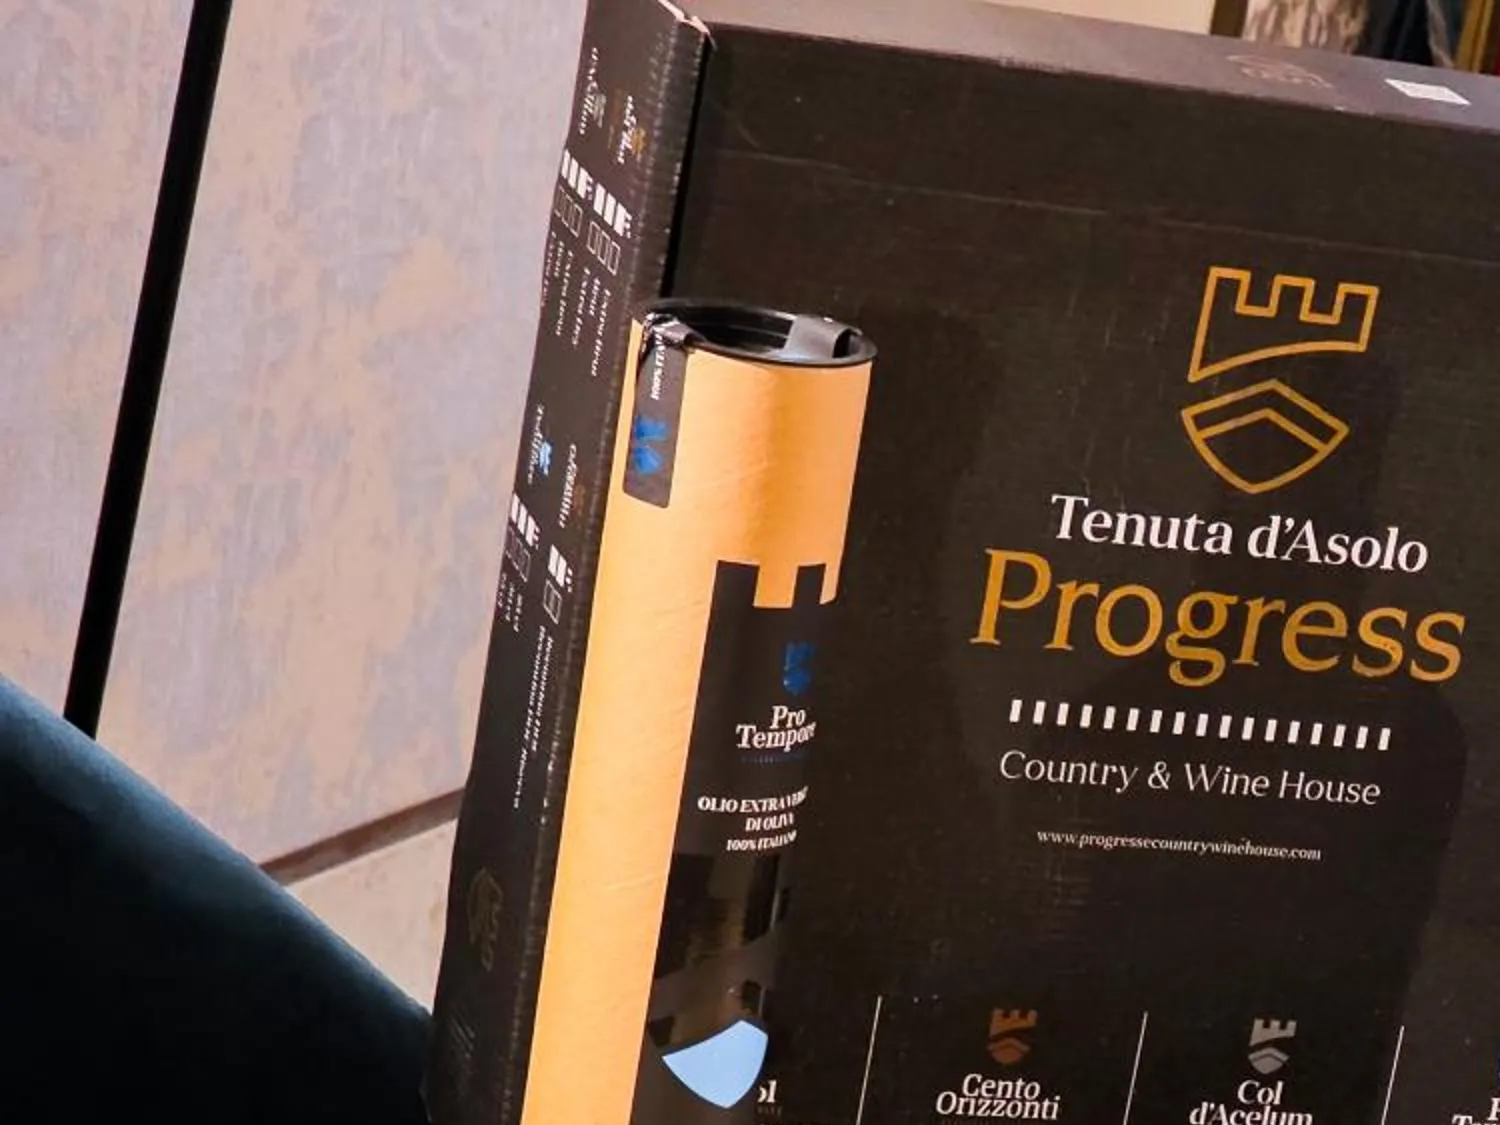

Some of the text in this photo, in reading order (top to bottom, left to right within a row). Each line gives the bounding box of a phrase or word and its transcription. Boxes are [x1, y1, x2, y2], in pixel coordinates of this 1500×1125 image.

[1052, 494, 1430, 574] Tenuta d'Asolo
[969, 548, 1466, 688] Progress
[769, 705, 806, 729] Pro
[1000, 750, 1381, 806] Country & Wine House
[697, 796, 739, 813] OLIO
[745, 817, 761, 831] DI
[962, 1073, 1040, 1100] Cento
[1237, 1080, 1283, 1105] Col
[936, 1091, 1060, 1119] Orizzonti
